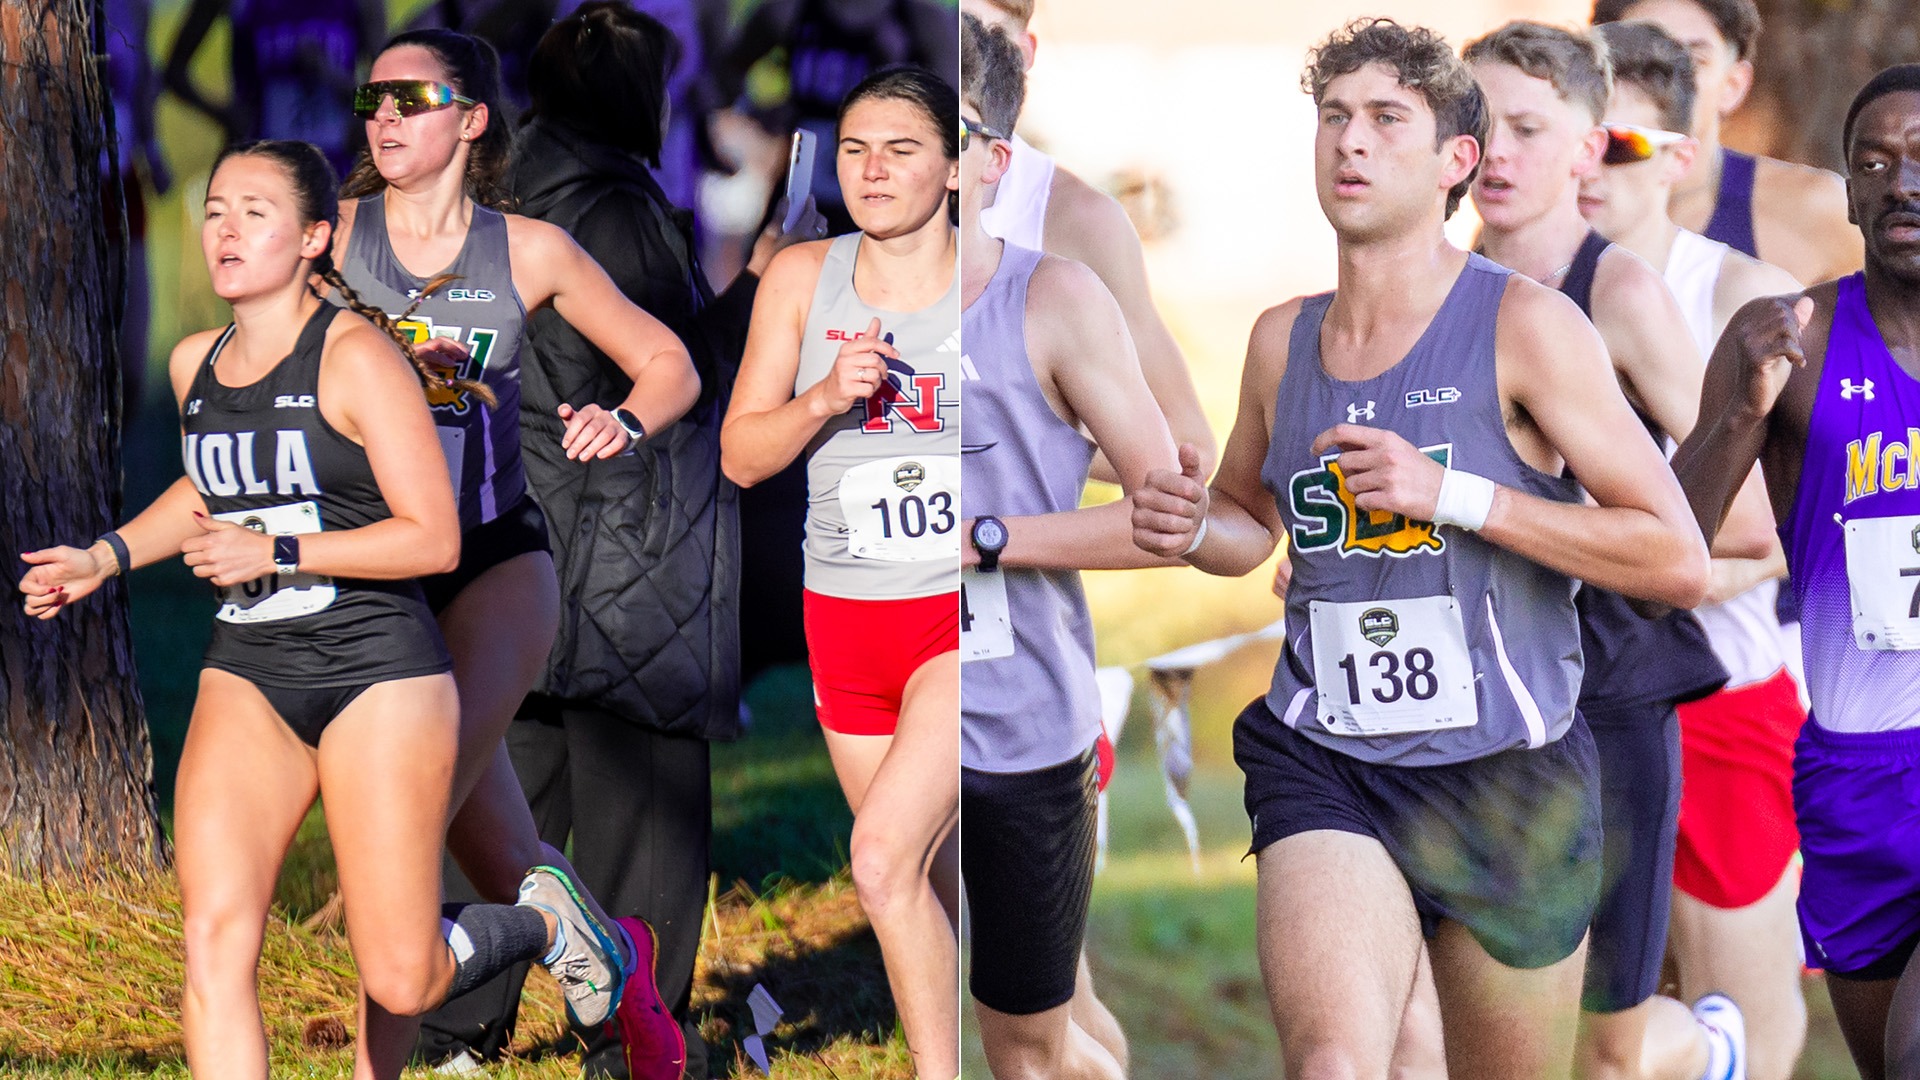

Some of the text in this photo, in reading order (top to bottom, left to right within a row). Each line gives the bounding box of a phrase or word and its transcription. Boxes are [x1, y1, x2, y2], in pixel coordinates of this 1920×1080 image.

[448, 289, 495, 302] SLC
[274, 395, 315, 408] SLC
[859, 372, 946, 434] N
[1405, 387, 1462, 408] SLC
[871, 491, 955, 538] 103
[1338, 647, 1438, 705] 138
